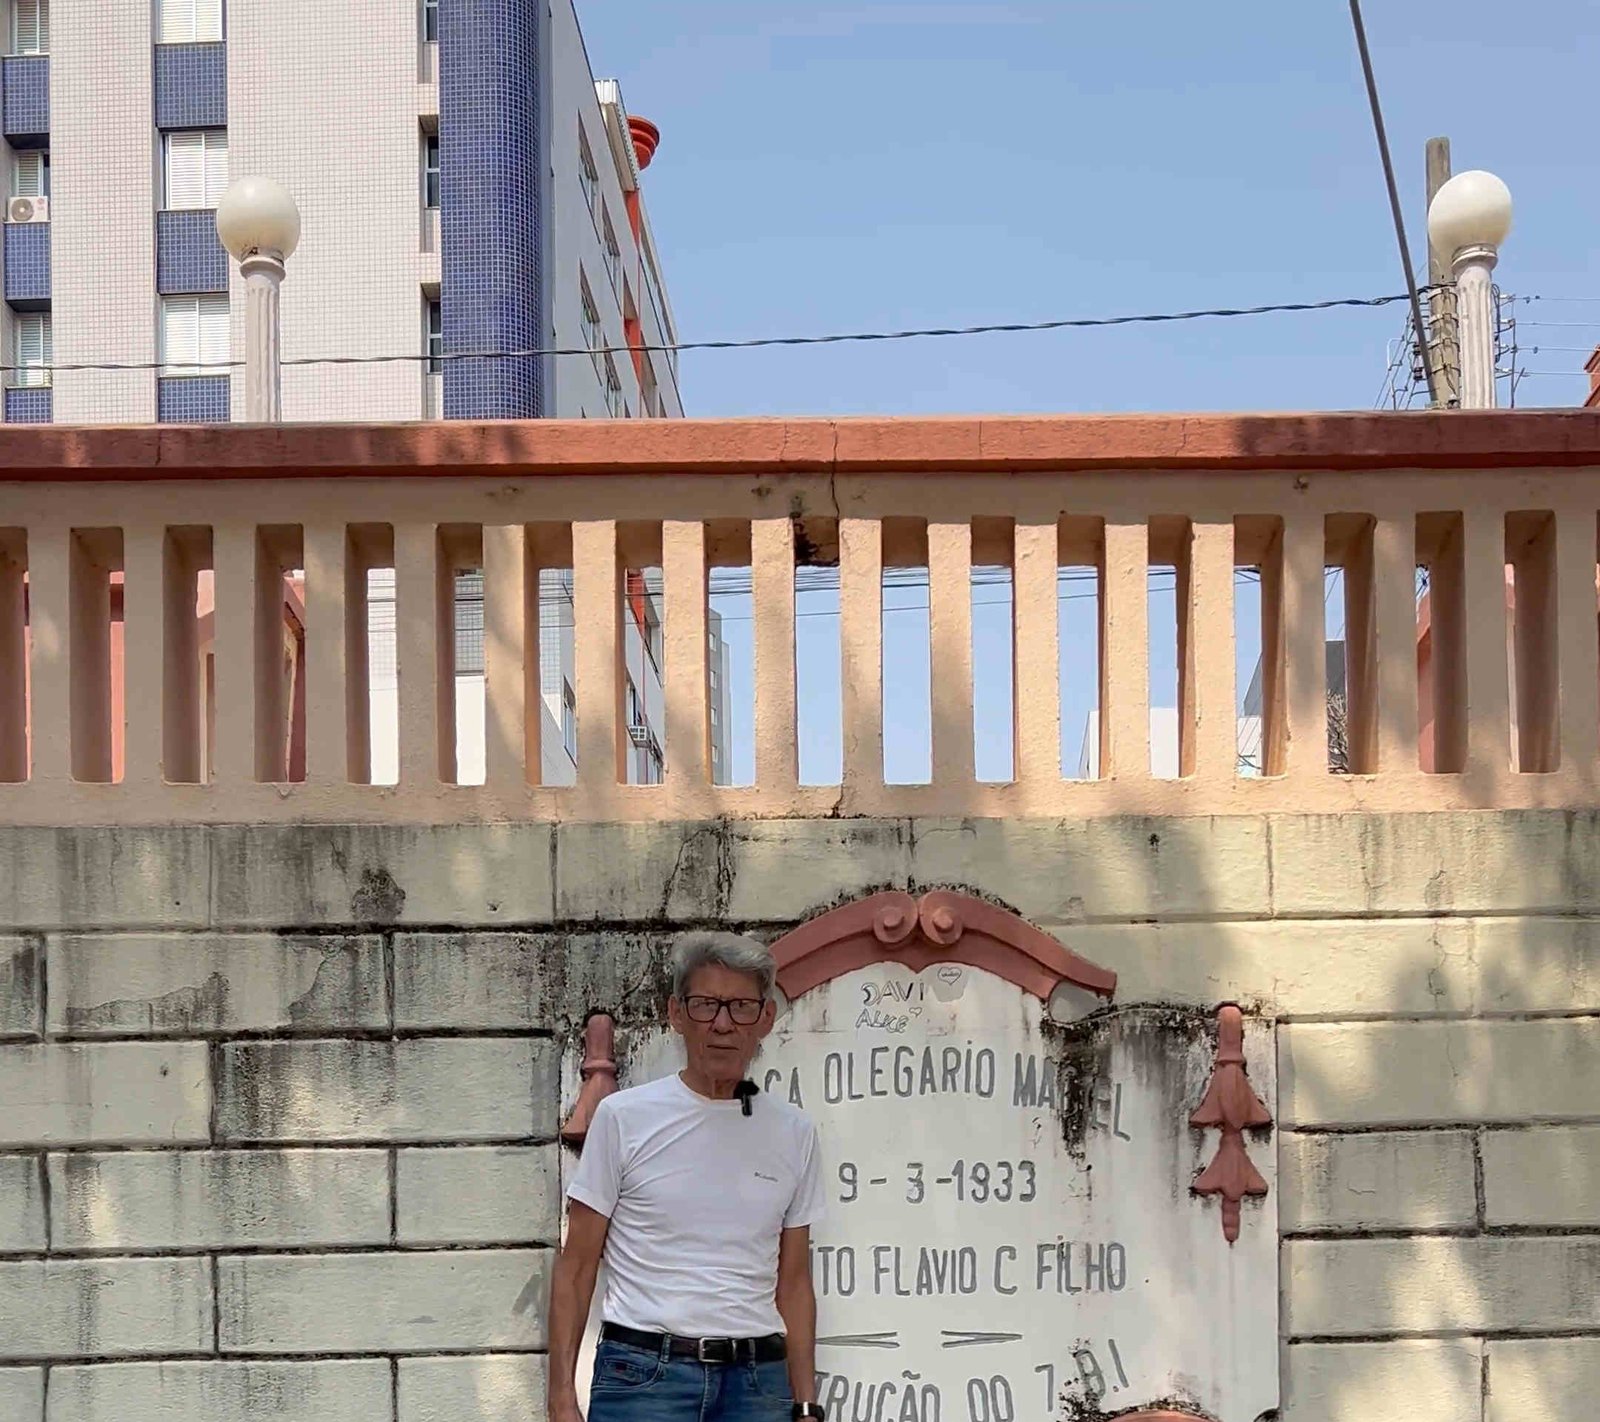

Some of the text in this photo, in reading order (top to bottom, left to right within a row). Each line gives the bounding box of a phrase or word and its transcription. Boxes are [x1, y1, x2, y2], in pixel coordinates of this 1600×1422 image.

[860, 979, 925, 1006] DAVI
[1012, 1052, 1131, 1141] MAEL
[873, 1246, 977, 1297] FLAVIO
[993, 1245, 1018, 1295] C
[1036, 1235, 1126, 1295] FILHO
